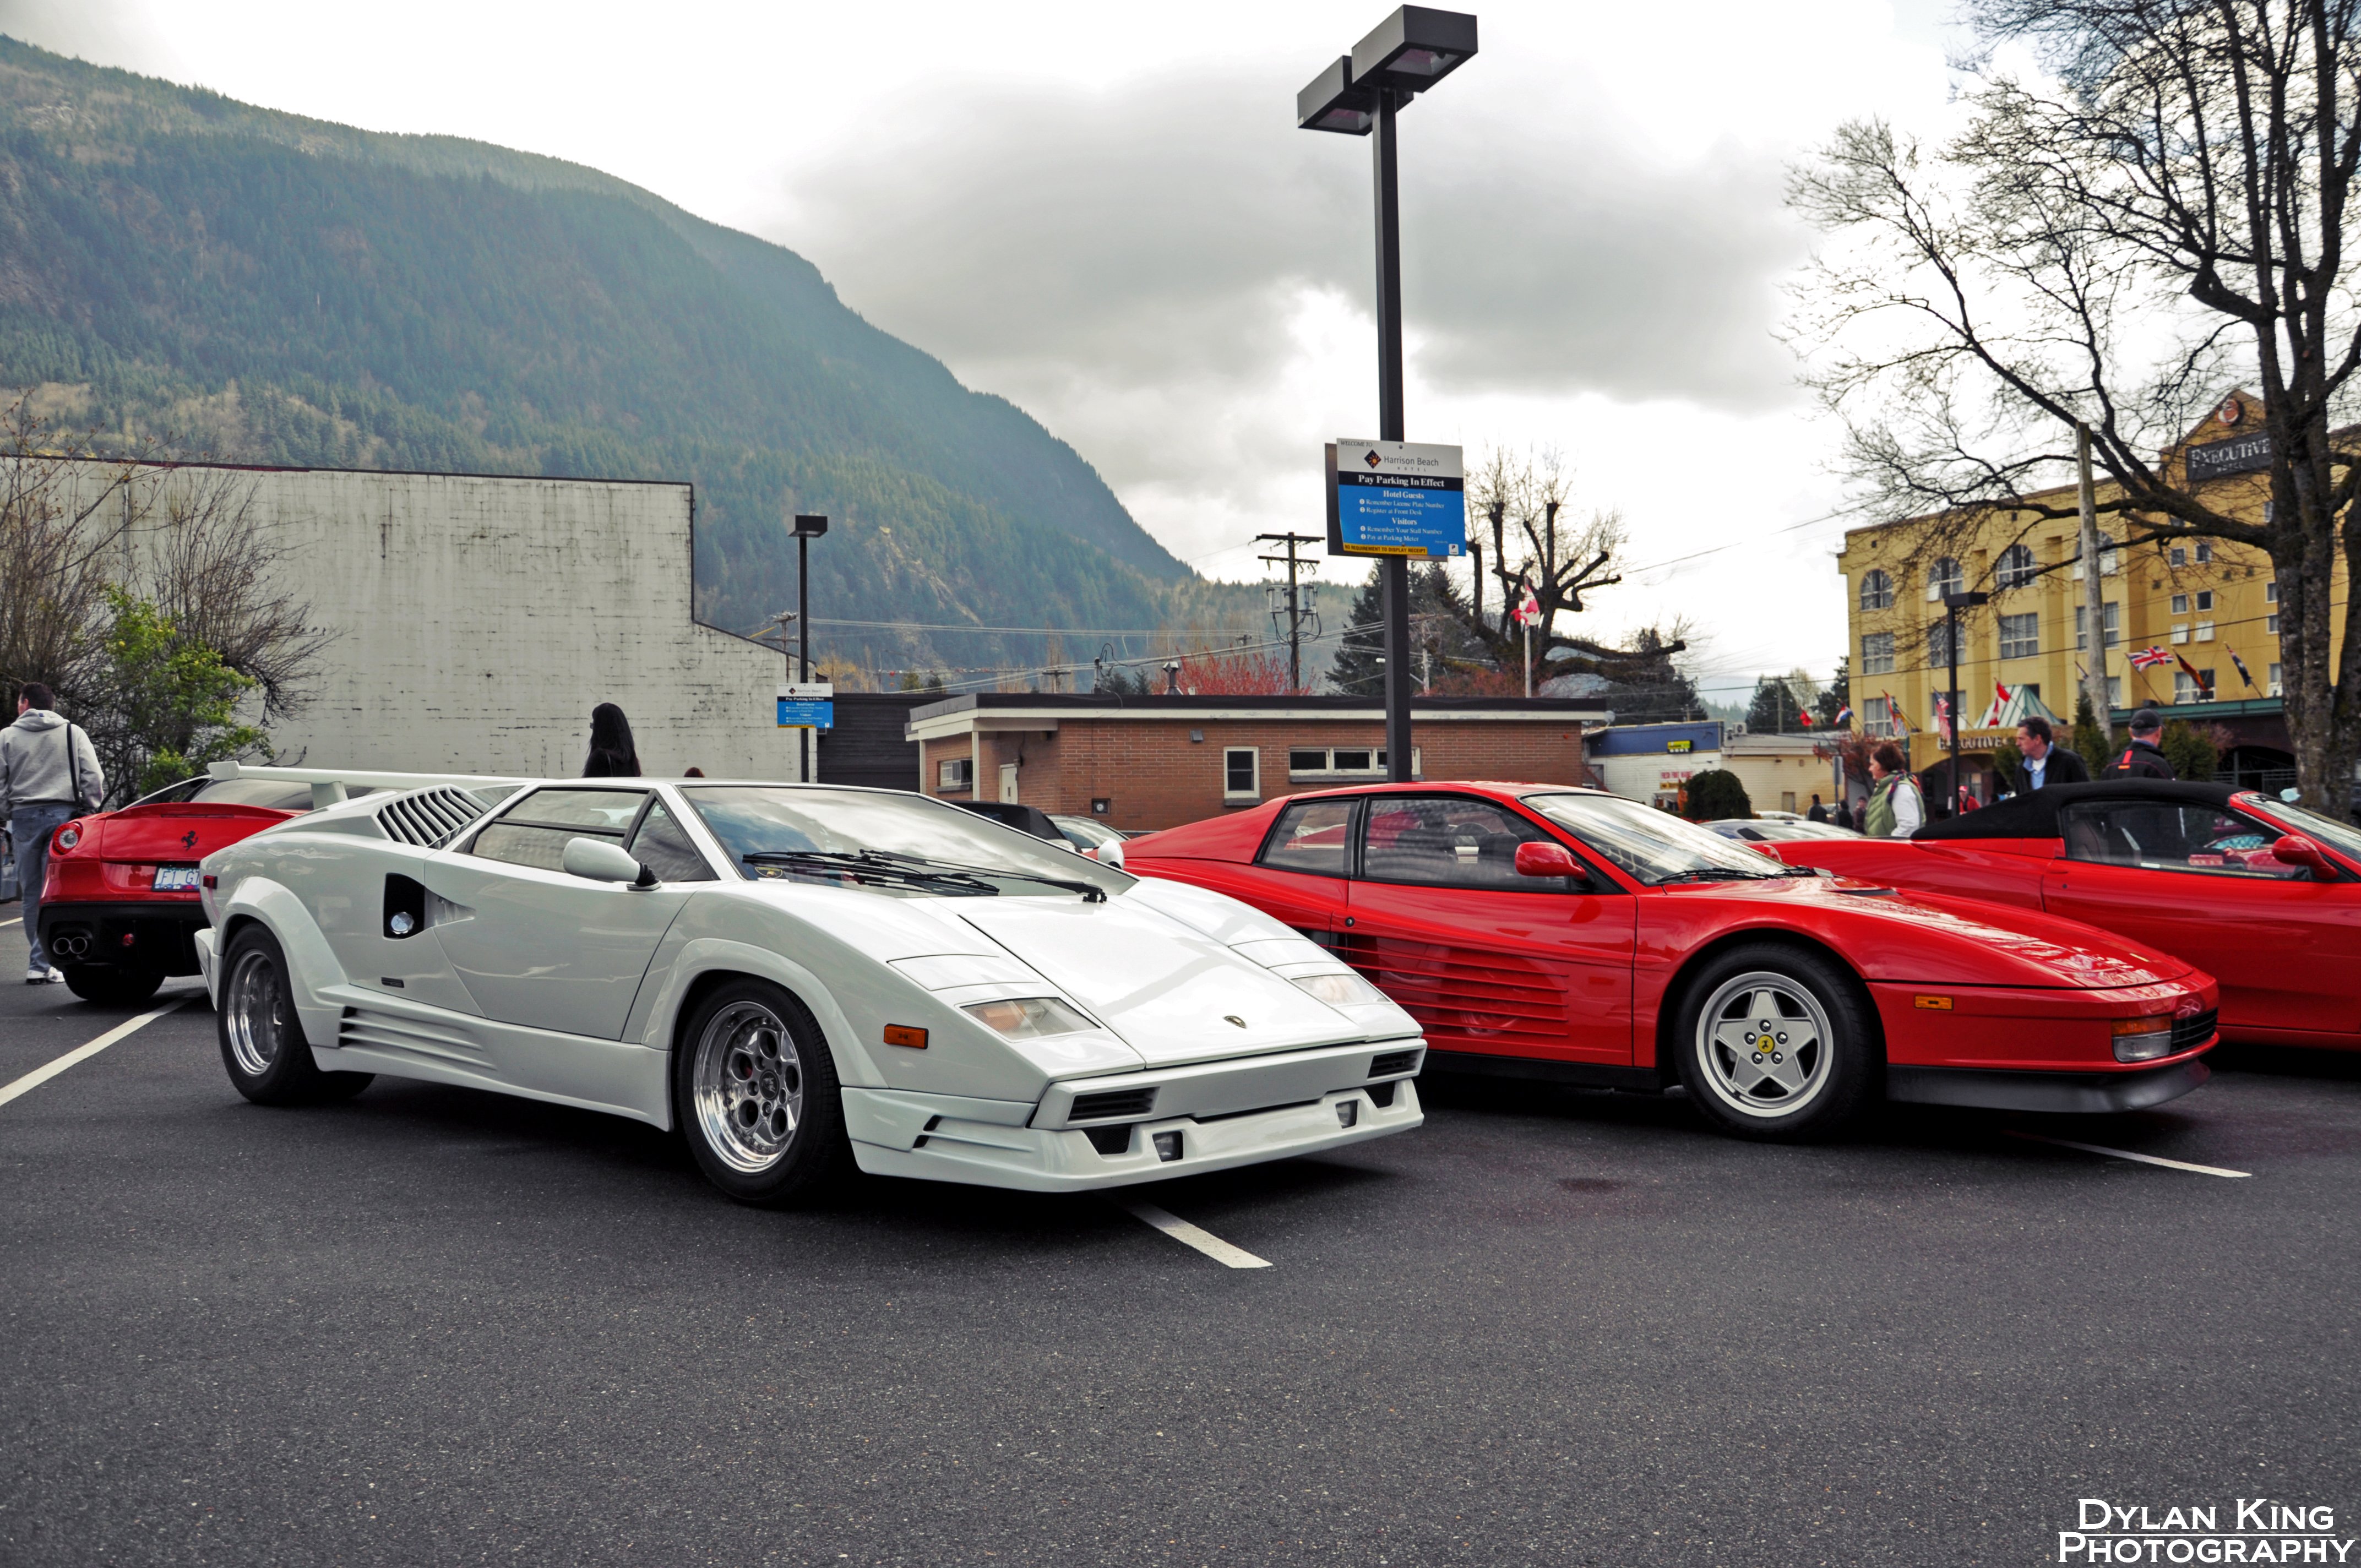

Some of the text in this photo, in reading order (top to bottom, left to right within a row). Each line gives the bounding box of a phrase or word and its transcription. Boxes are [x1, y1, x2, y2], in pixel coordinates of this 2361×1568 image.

[1384, 455, 1439, 466] Harrison Beach
[1358, 475, 1444, 487] Pay Parking In Effect
[1383, 490, 1424, 499] Hotel Guests
[1391, 517, 1417, 525] Visitors
[1937, 736, 2002, 750] ECUTIVE
[161, 870, 176, 884] F1
